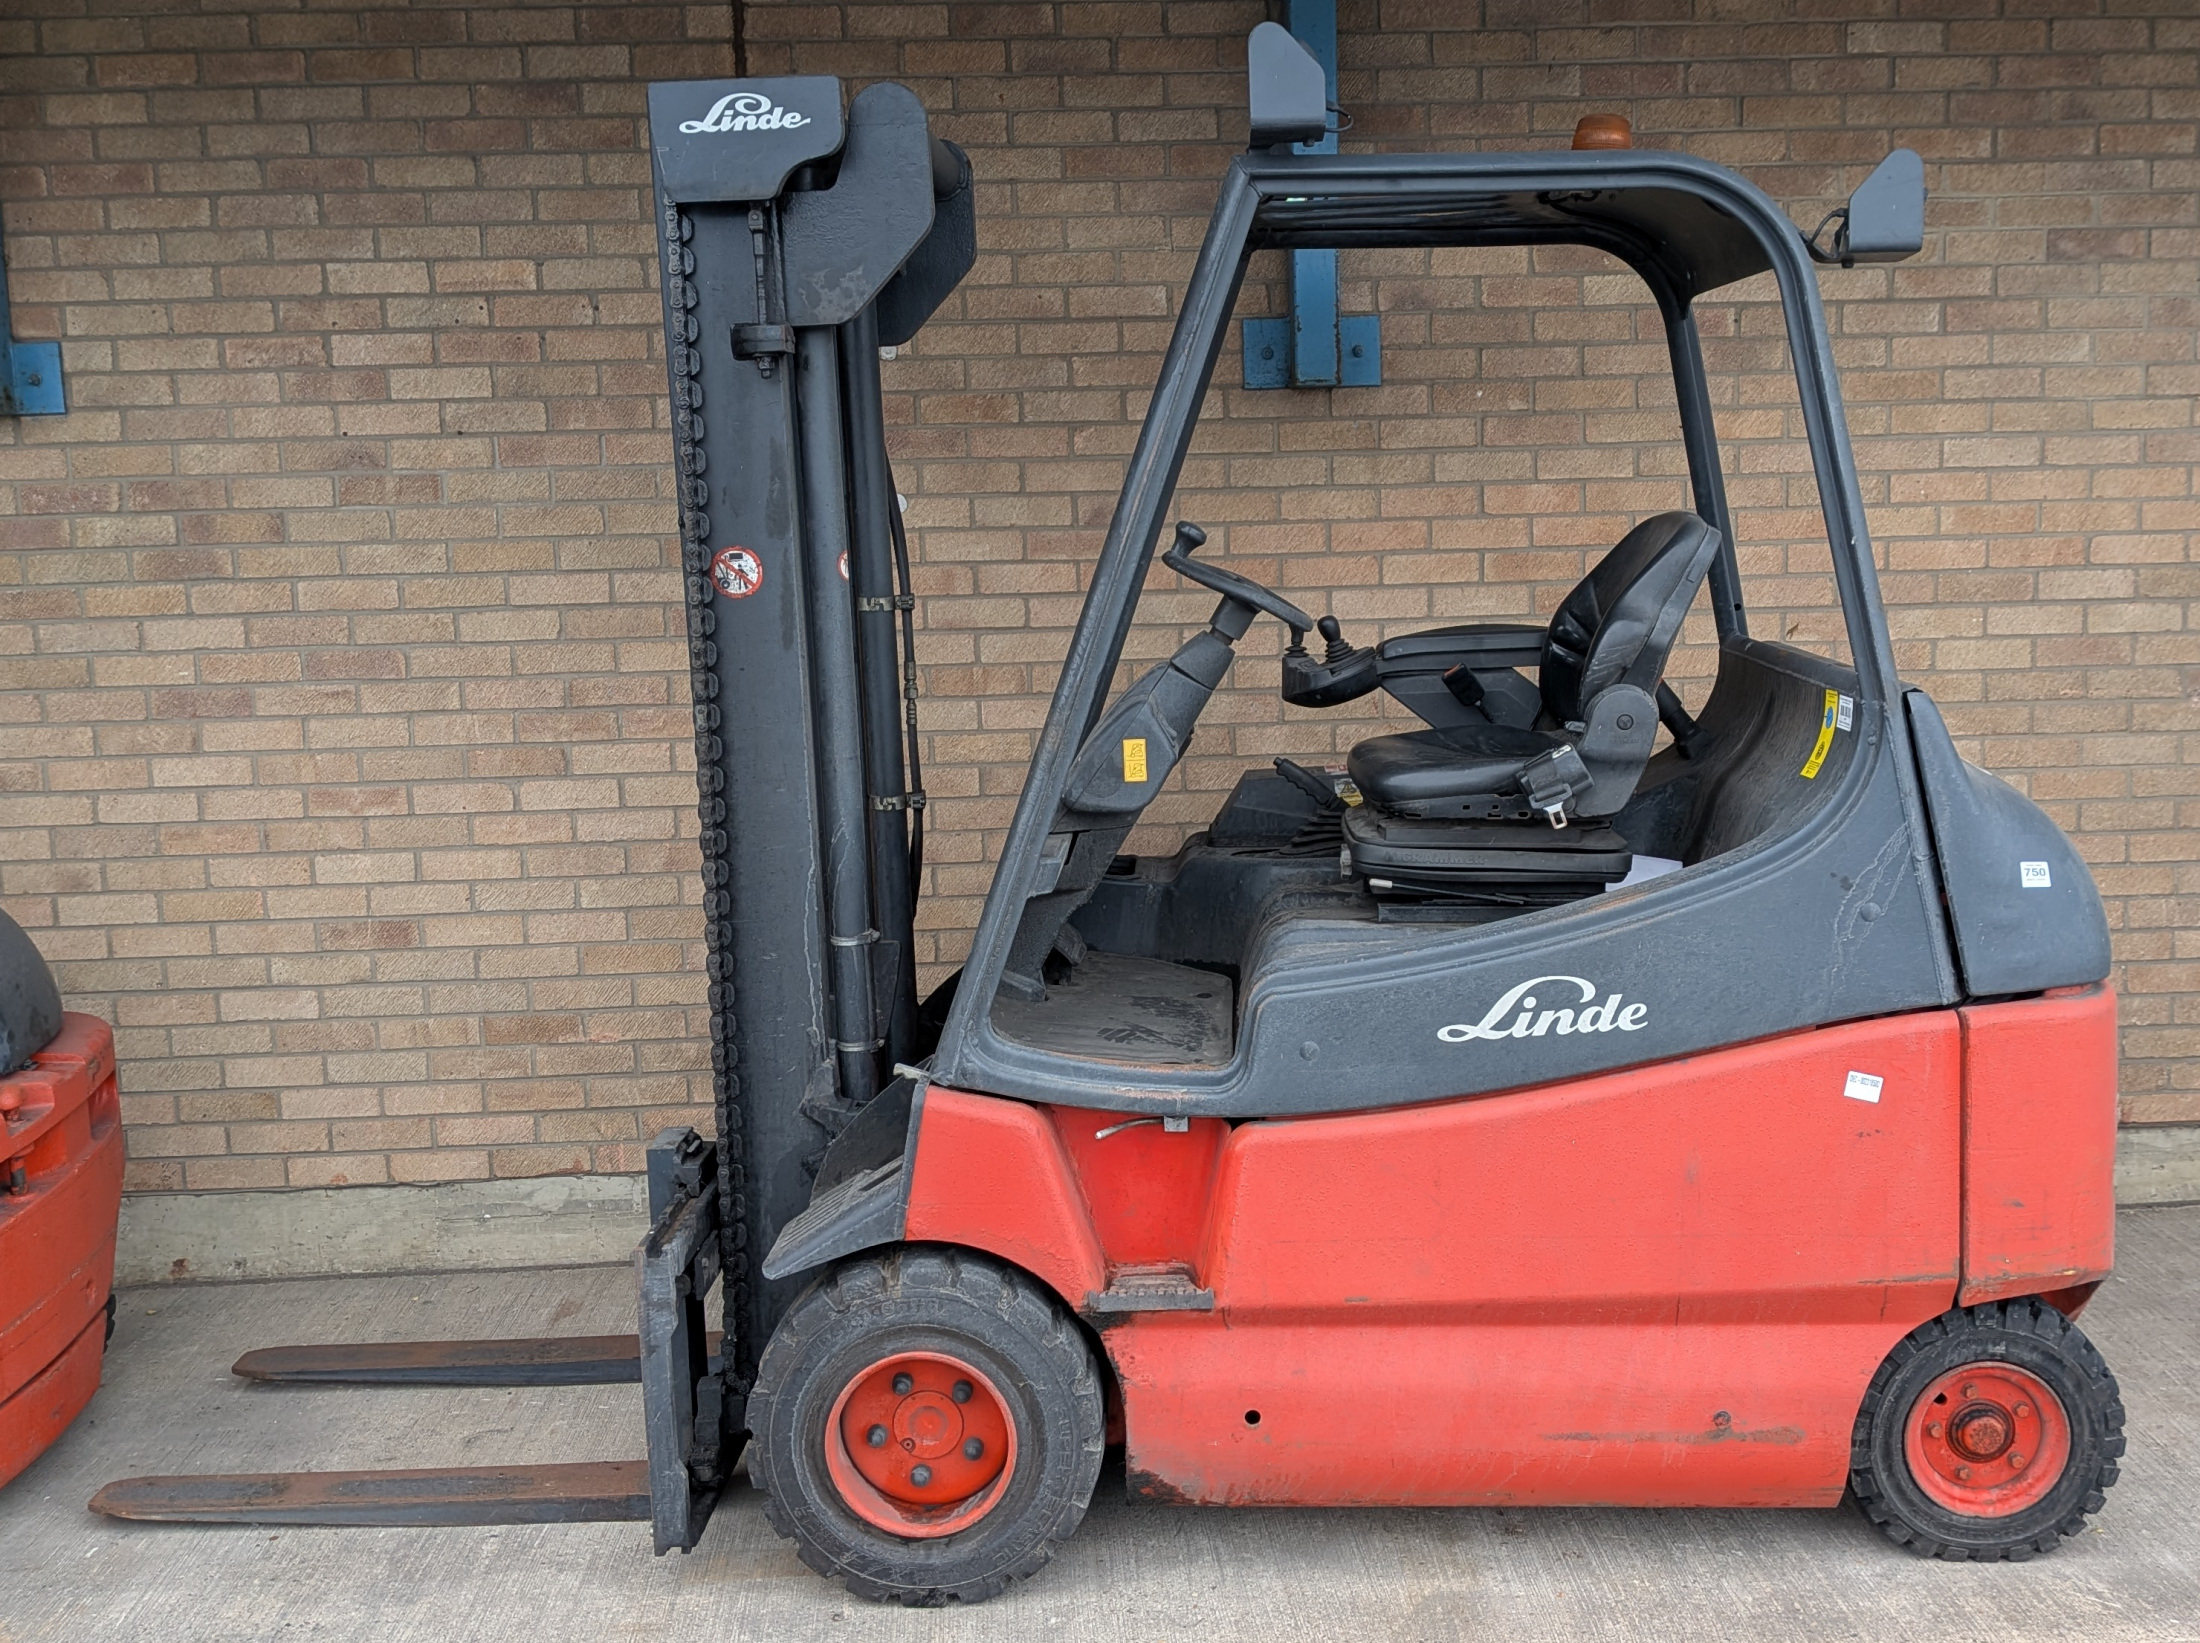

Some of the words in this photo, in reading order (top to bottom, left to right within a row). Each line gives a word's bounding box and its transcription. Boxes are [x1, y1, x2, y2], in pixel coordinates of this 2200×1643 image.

[679, 93, 811, 133] Linde
[1403, 853, 1486, 865] GRAMMER
[2024, 868, 2046, 877] 750
[1437, 976, 1648, 1042] Linde
